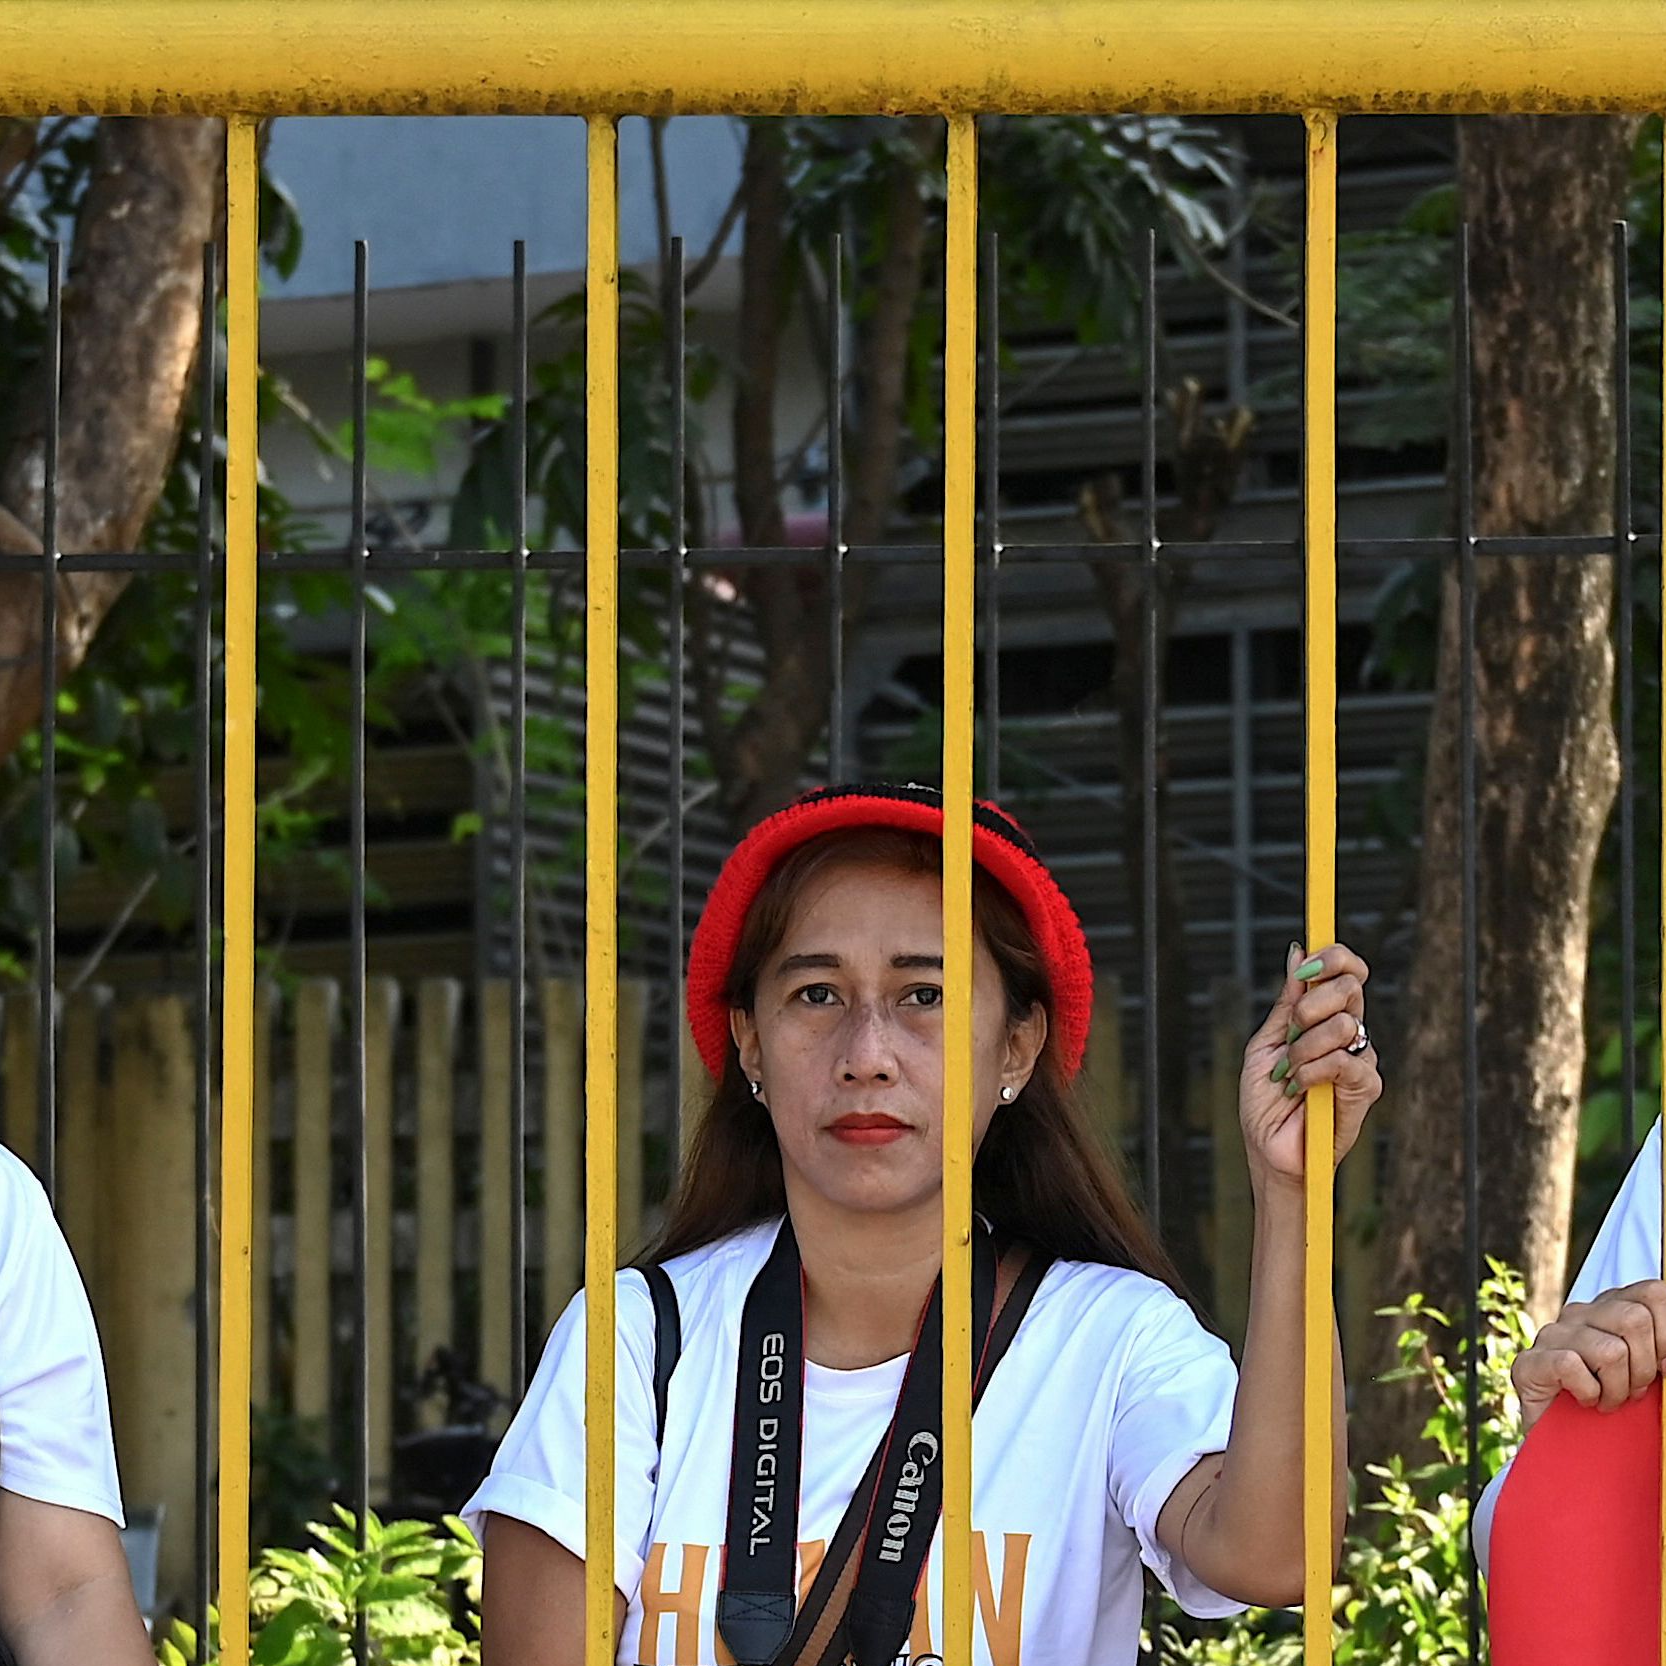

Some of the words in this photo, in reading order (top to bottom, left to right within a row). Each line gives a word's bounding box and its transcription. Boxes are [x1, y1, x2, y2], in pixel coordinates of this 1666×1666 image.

[760, 1332, 785, 1403] EOS
[749, 1417, 779, 1556] DIGITAL
[878, 1431, 940, 1563] Canon
